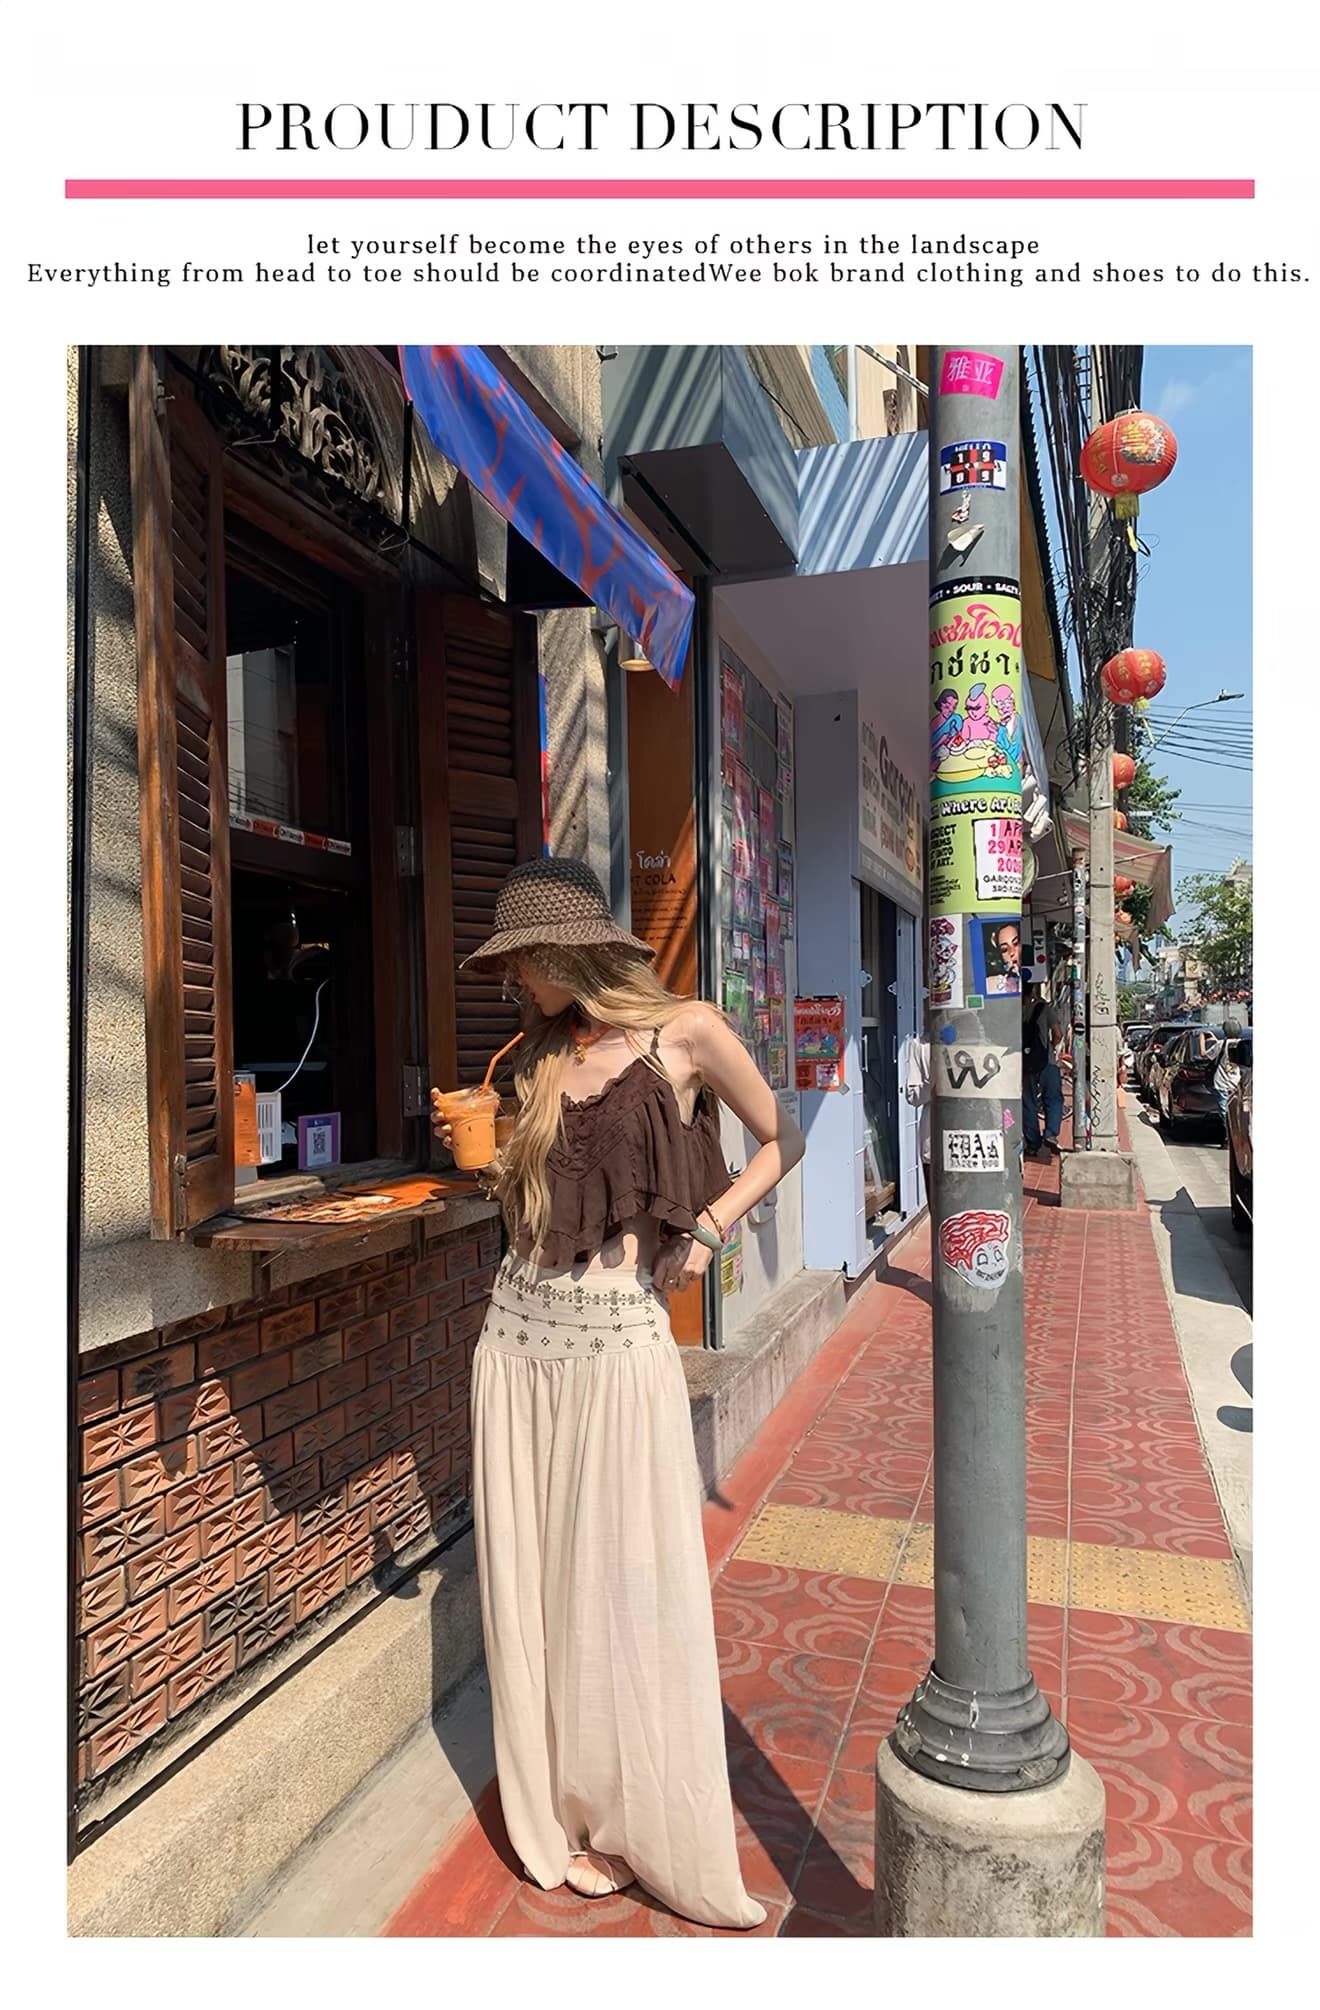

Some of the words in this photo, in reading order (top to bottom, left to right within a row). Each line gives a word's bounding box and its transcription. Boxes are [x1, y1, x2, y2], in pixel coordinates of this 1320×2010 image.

[952, 582, 984, 595] SOUR
[940, 797, 988, 817] Where
[990, 823, 997, 838] 1
[987, 839, 1006, 855] 29
